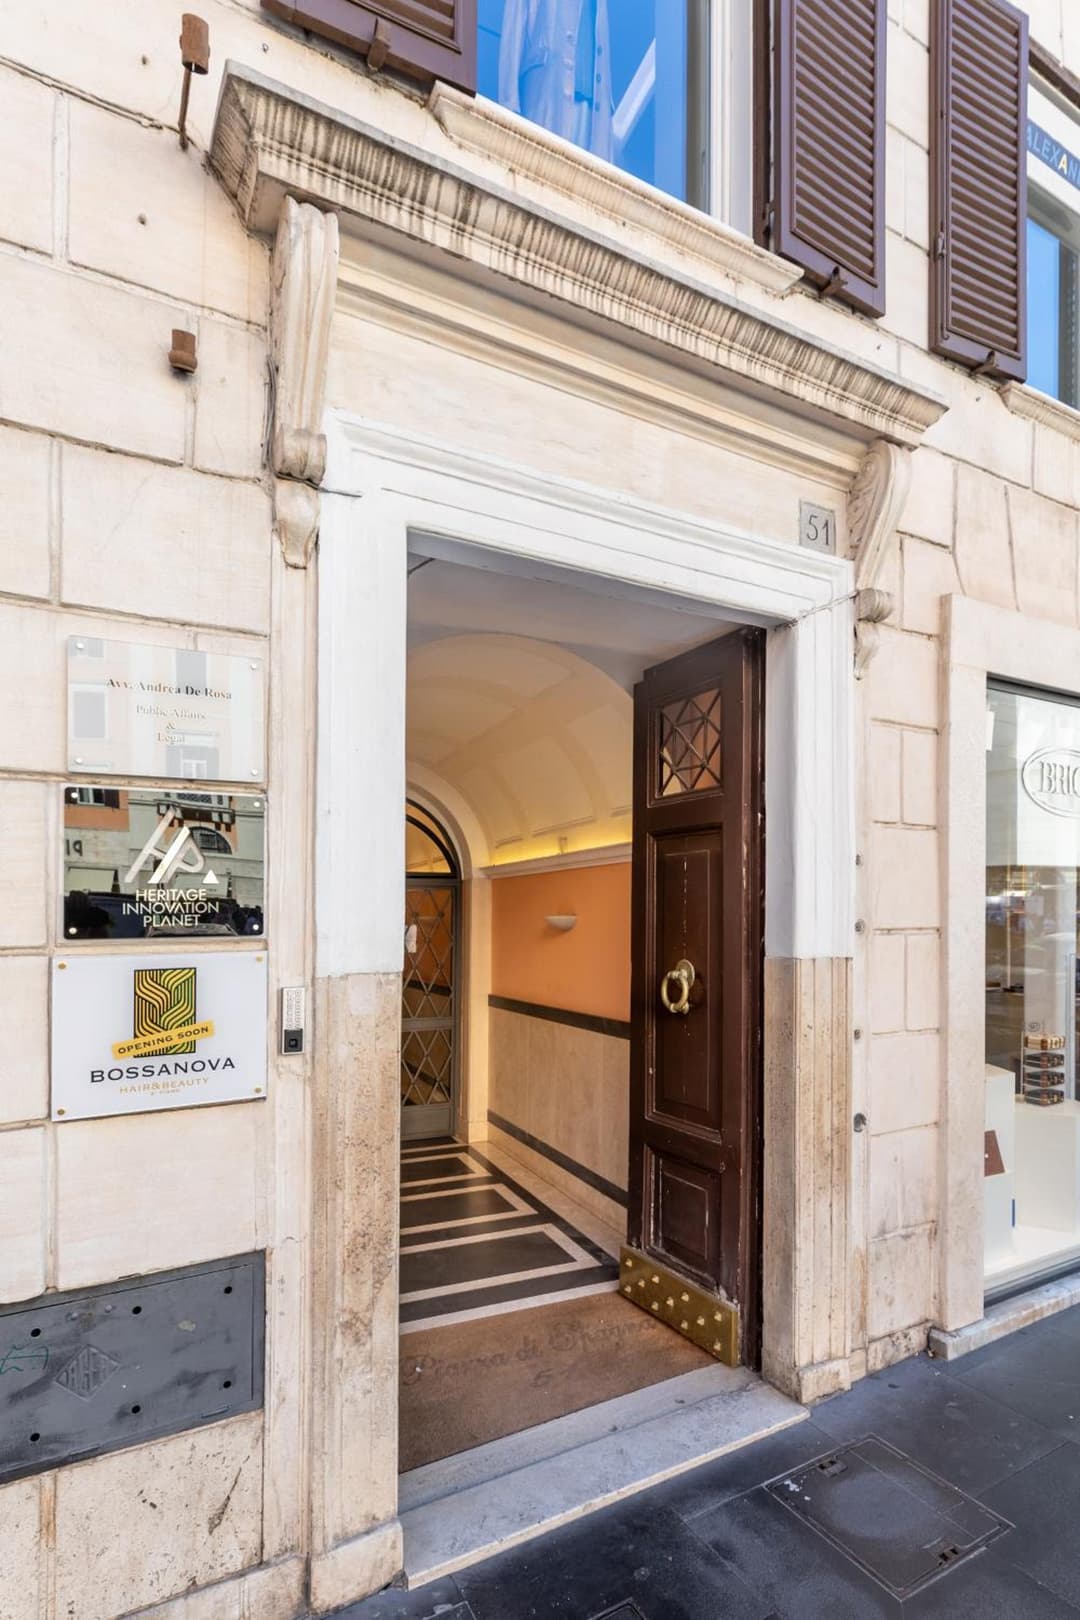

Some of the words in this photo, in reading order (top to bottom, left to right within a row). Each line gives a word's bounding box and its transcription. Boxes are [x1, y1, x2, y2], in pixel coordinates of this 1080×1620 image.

[806, 514, 829, 545] 51
[138, 681, 181, 695] Andrea
[185, 685, 201, 697] De
[205, 687, 232, 700] Rosa
[136, 704, 167, 717] Public
[135, 889, 207, 901] HERITAGE
[122, 902, 220, 915] INNOVATION
[143, 915, 200, 928] PLANET
[118, 1034, 173, 1055] OPENING
[178, 1025, 209, 1039] SOON
[90, 1057, 236, 1083] BOSSANOVA
